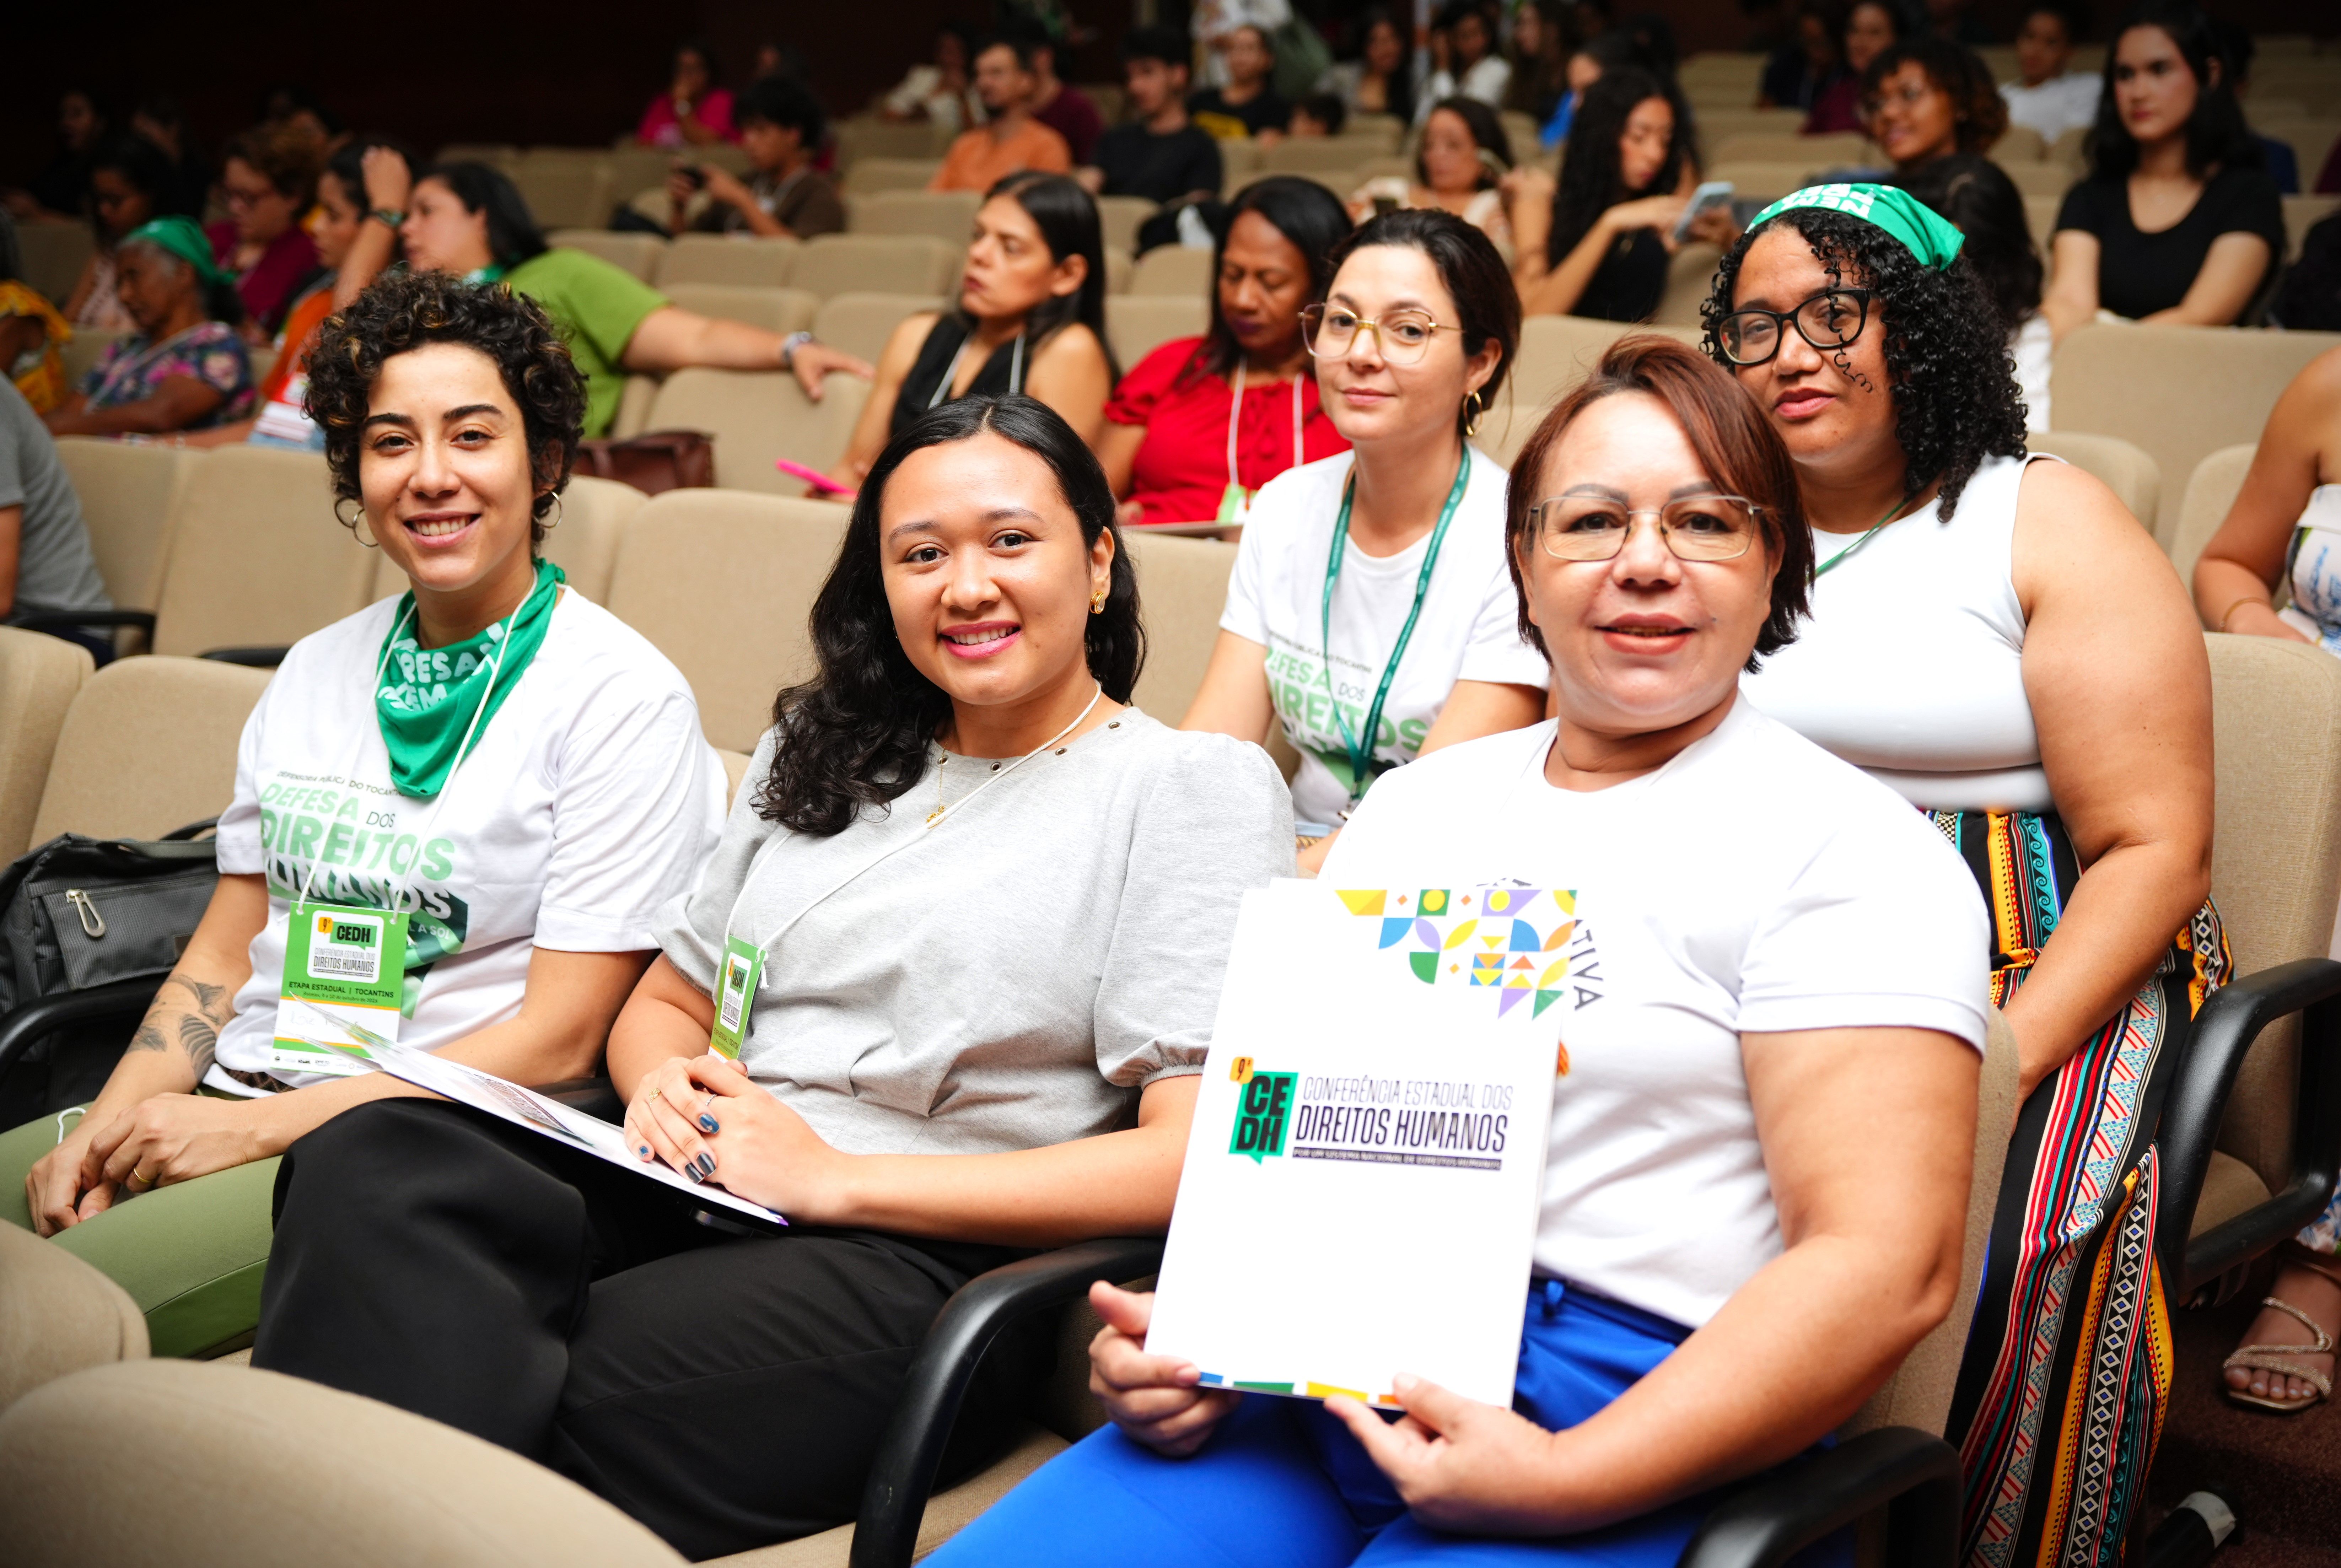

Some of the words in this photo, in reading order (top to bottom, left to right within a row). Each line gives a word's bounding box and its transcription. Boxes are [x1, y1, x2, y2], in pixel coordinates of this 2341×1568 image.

[1339, 682, 1366, 702] DOS
[1273, 677, 1427, 752] IREITOS
[349, 780, 364, 789] DO
[260, 783, 359, 821] DEFESA
[366, 811, 395, 828] DOS
[261, 809, 455, 881] DIREITOS
[337, 925, 371, 943] CEDH
[418, 924, 427, 934] A
[430, 925, 450, 939] SOL
[314, 956, 341, 969] DIREITOS
[342, 959, 374, 972] HUMANOS
[1571, 919, 1605, 1012] TIVA
[312, 984, 346, 993] ESTADUAL
[355, 988, 394, 998] TOCANTINS
[1245, 1075, 1291, 1118] CE
[1304, 1074, 1400, 1104] CONFERÊNCIA
[1405, 1081, 1475, 1108] ESTADUAL
[1482, 1084, 1513, 1110] DOS
[1236, 1117, 1282, 1153] DH
[1296, 1105, 1391, 1145] DIREITOS
[1394, 1110, 1507, 1153] HUMANOS
